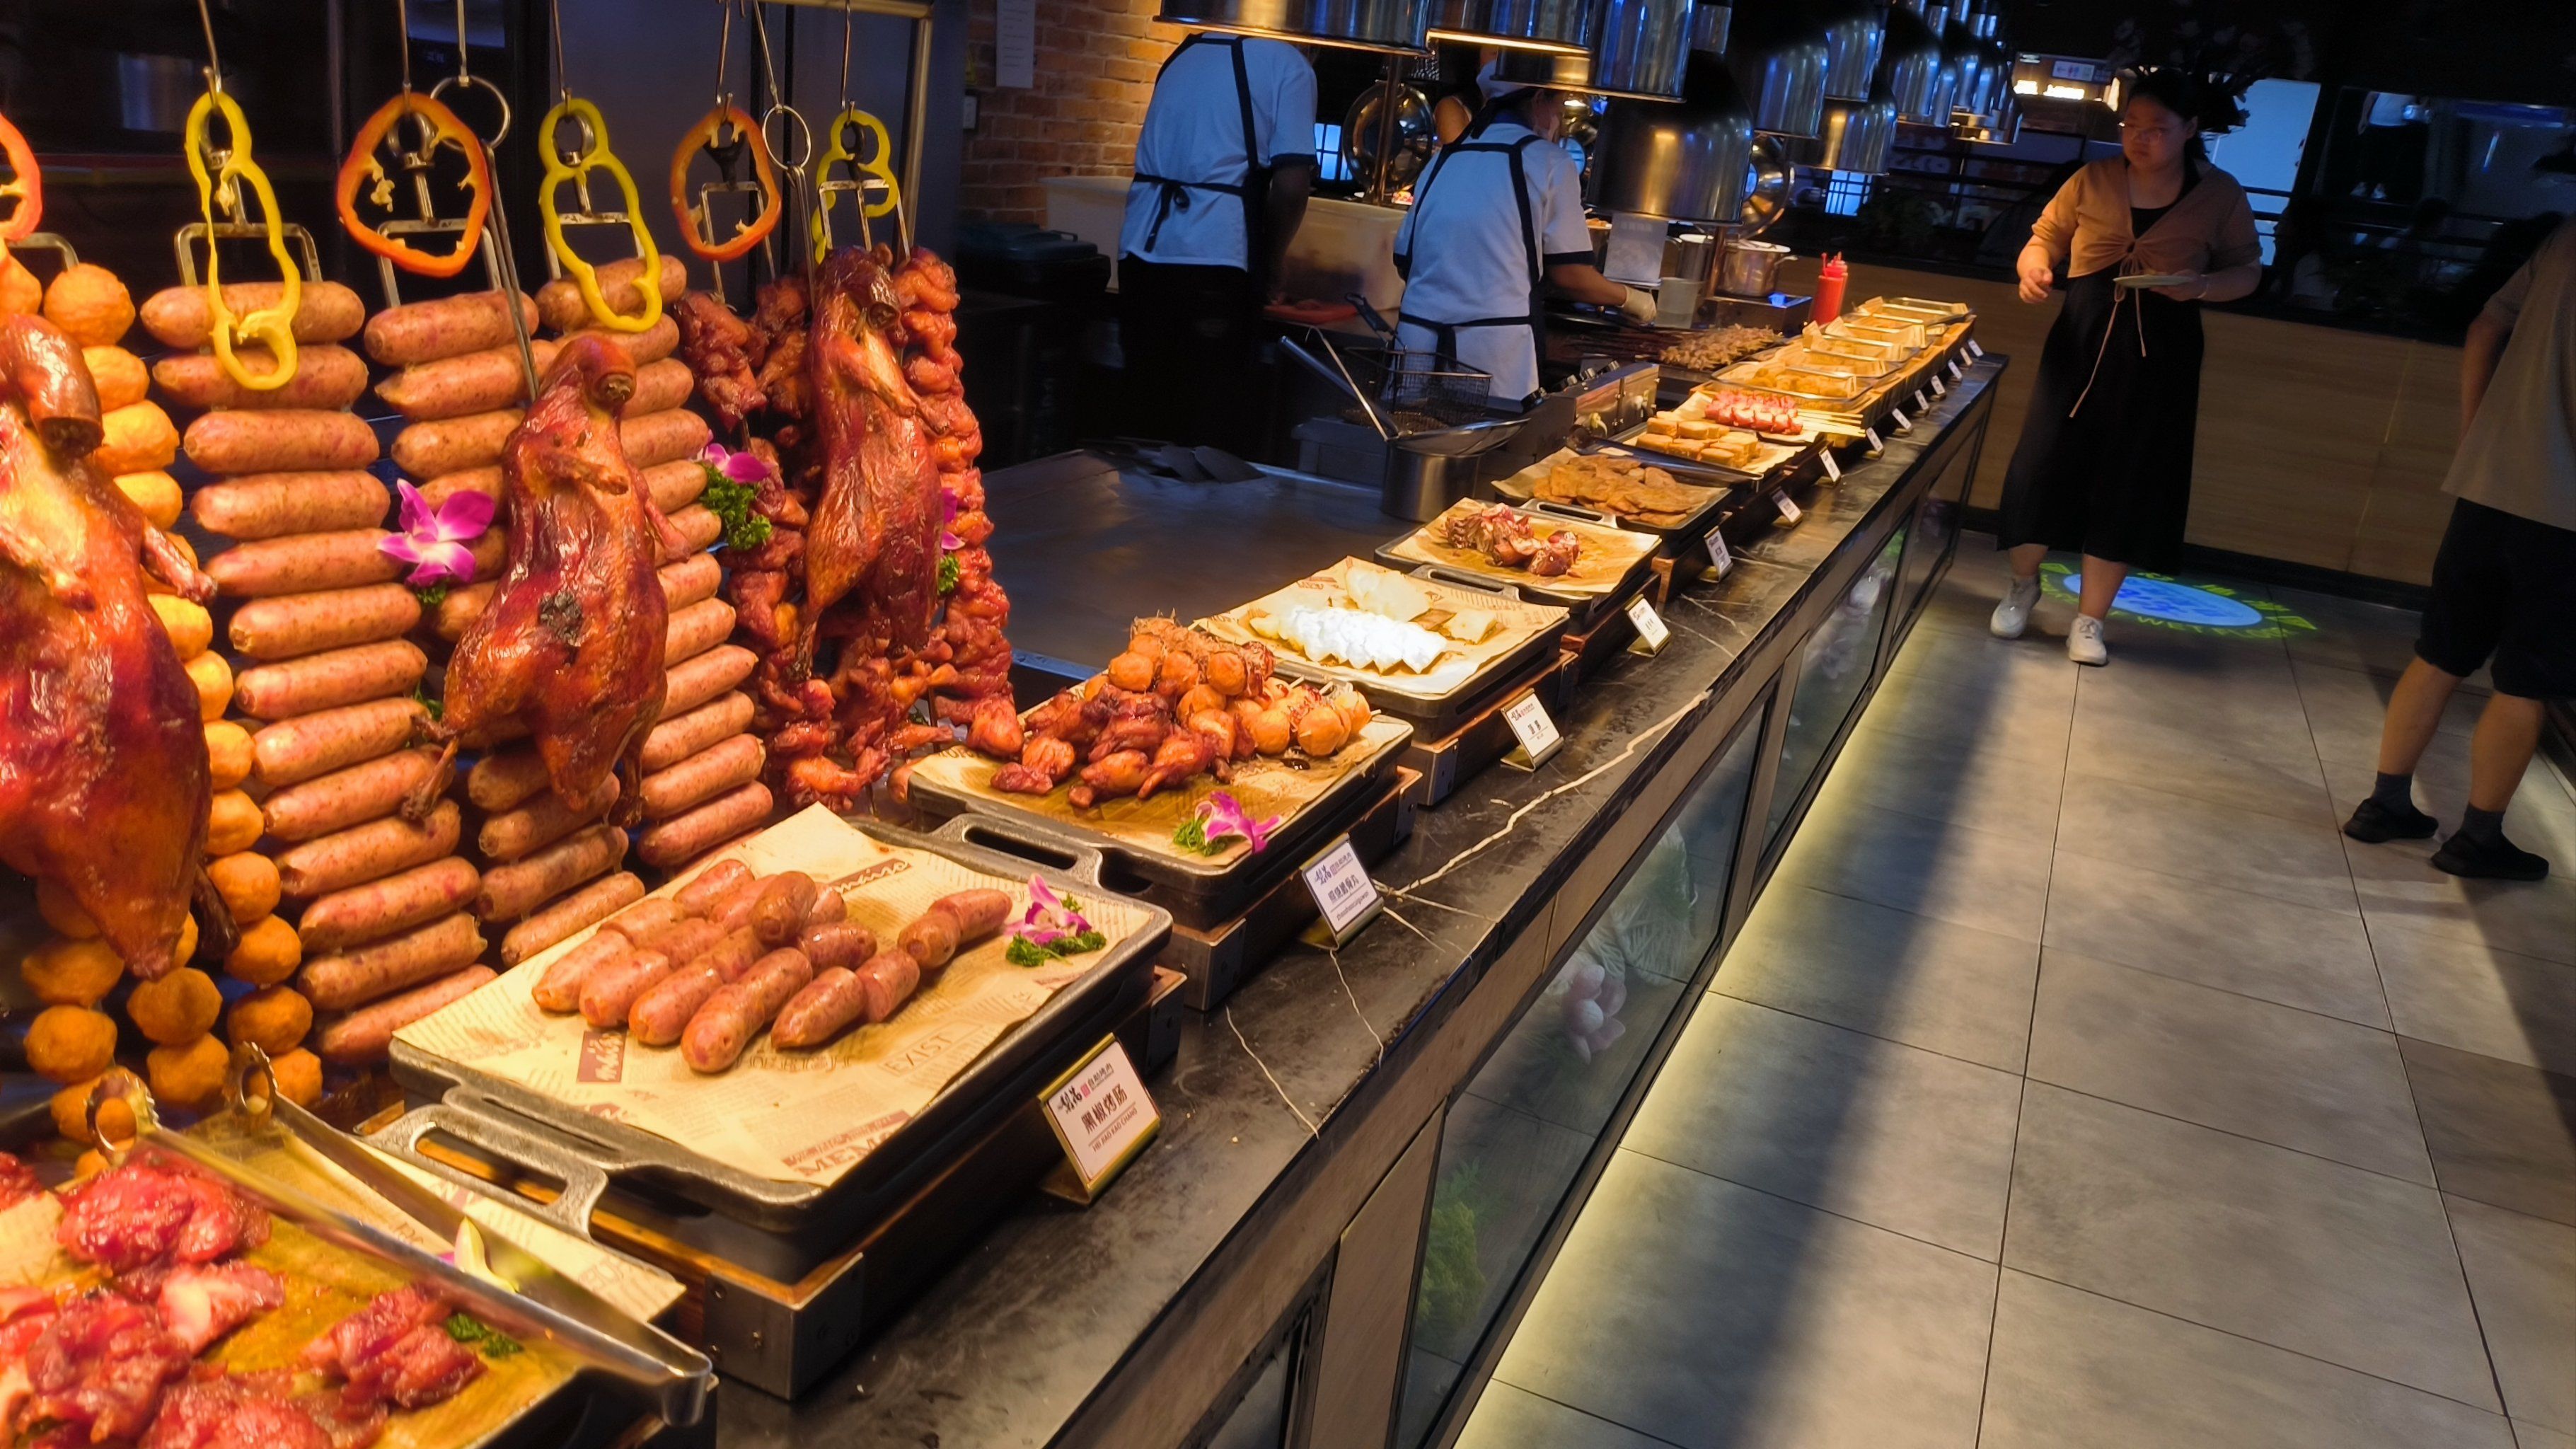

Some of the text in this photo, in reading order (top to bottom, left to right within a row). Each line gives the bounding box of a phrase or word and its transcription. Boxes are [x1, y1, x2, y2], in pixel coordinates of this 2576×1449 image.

[1081, 1083, 1128, 1133] 黑椒烤肠
[1092, 1108, 1138, 1152] HEI JIAO KAO CHANG
